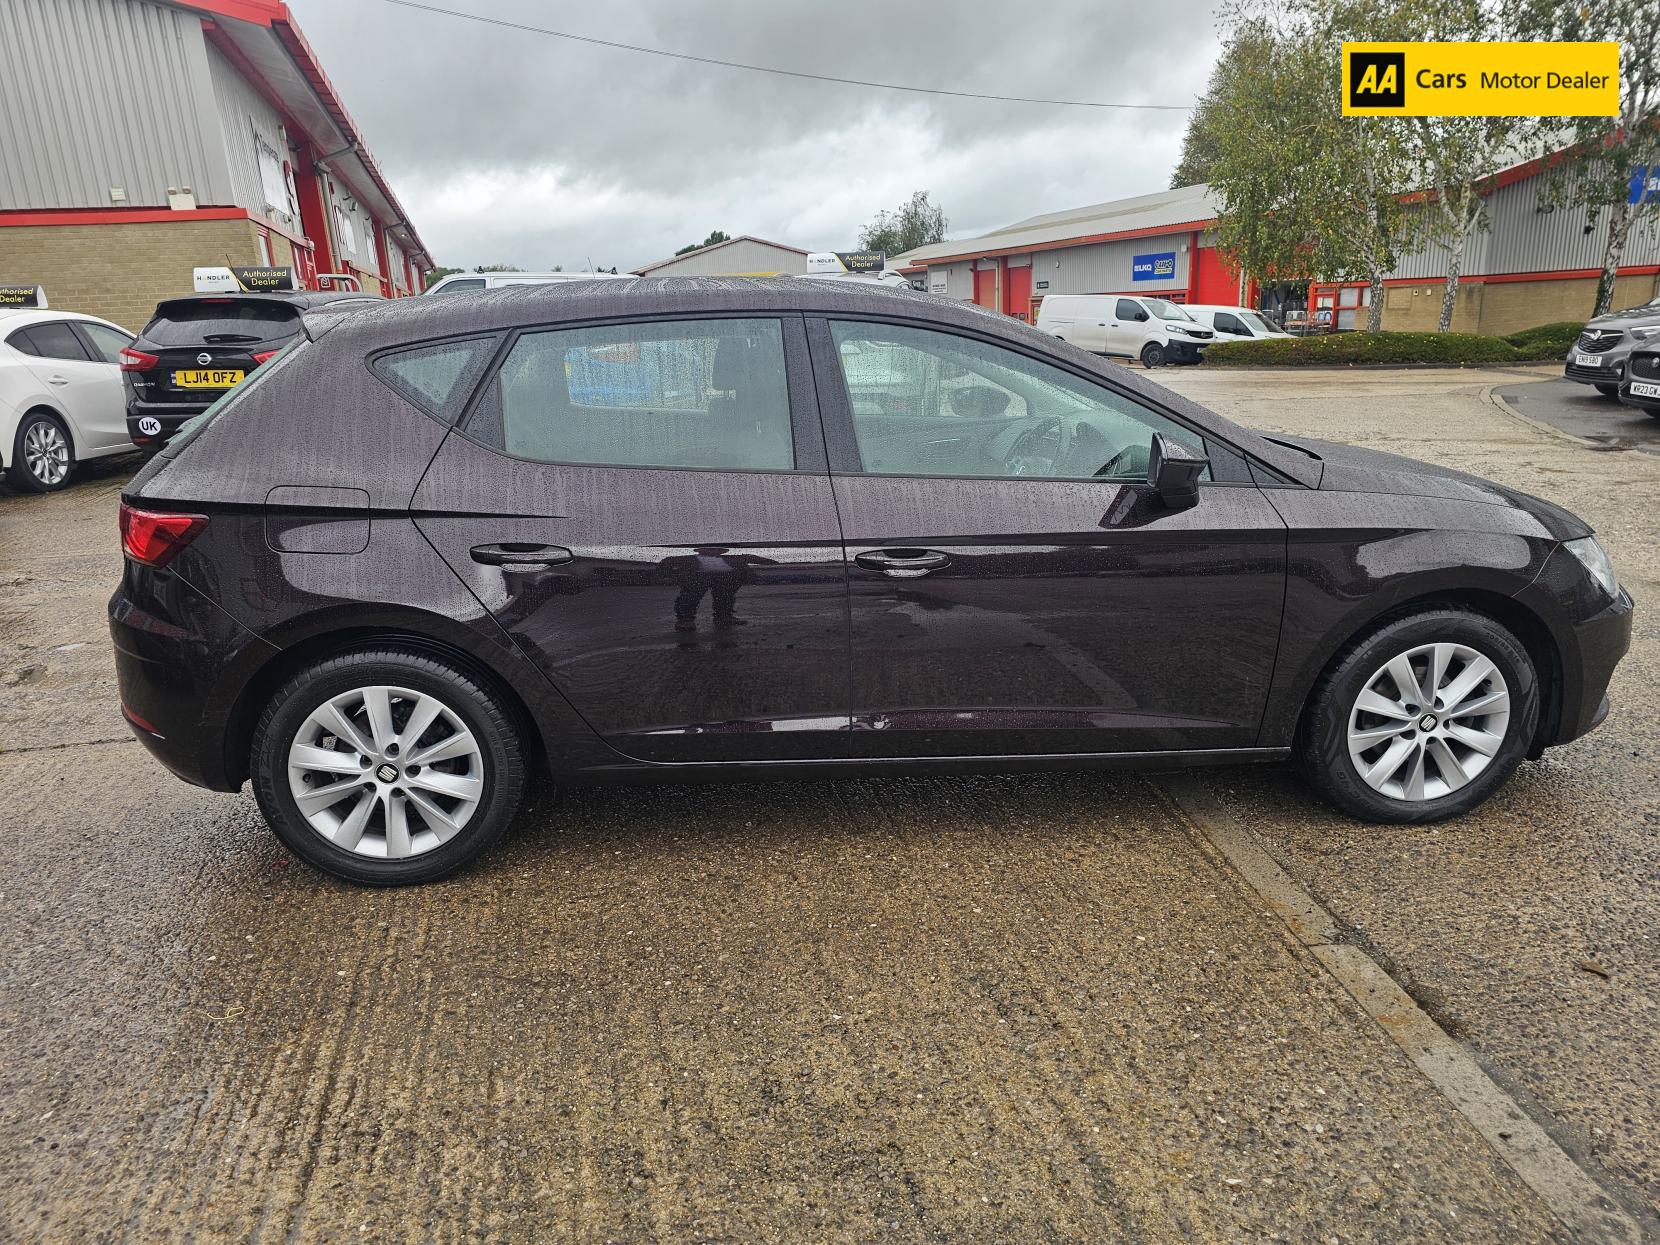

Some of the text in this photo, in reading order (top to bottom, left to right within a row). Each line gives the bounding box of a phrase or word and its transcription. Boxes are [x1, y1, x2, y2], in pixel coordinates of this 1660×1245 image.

[242, 269, 287, 278] Authorised
[251, 278, 279, 286] Dealer
[0, 295, 25, 303] Dealer
[184, 372, 209, 384] LJ14
[213, 372, 237, 383] OFZ
[1649, 386, 1660, 397] GW
[141, 421, 158, 431] UK
